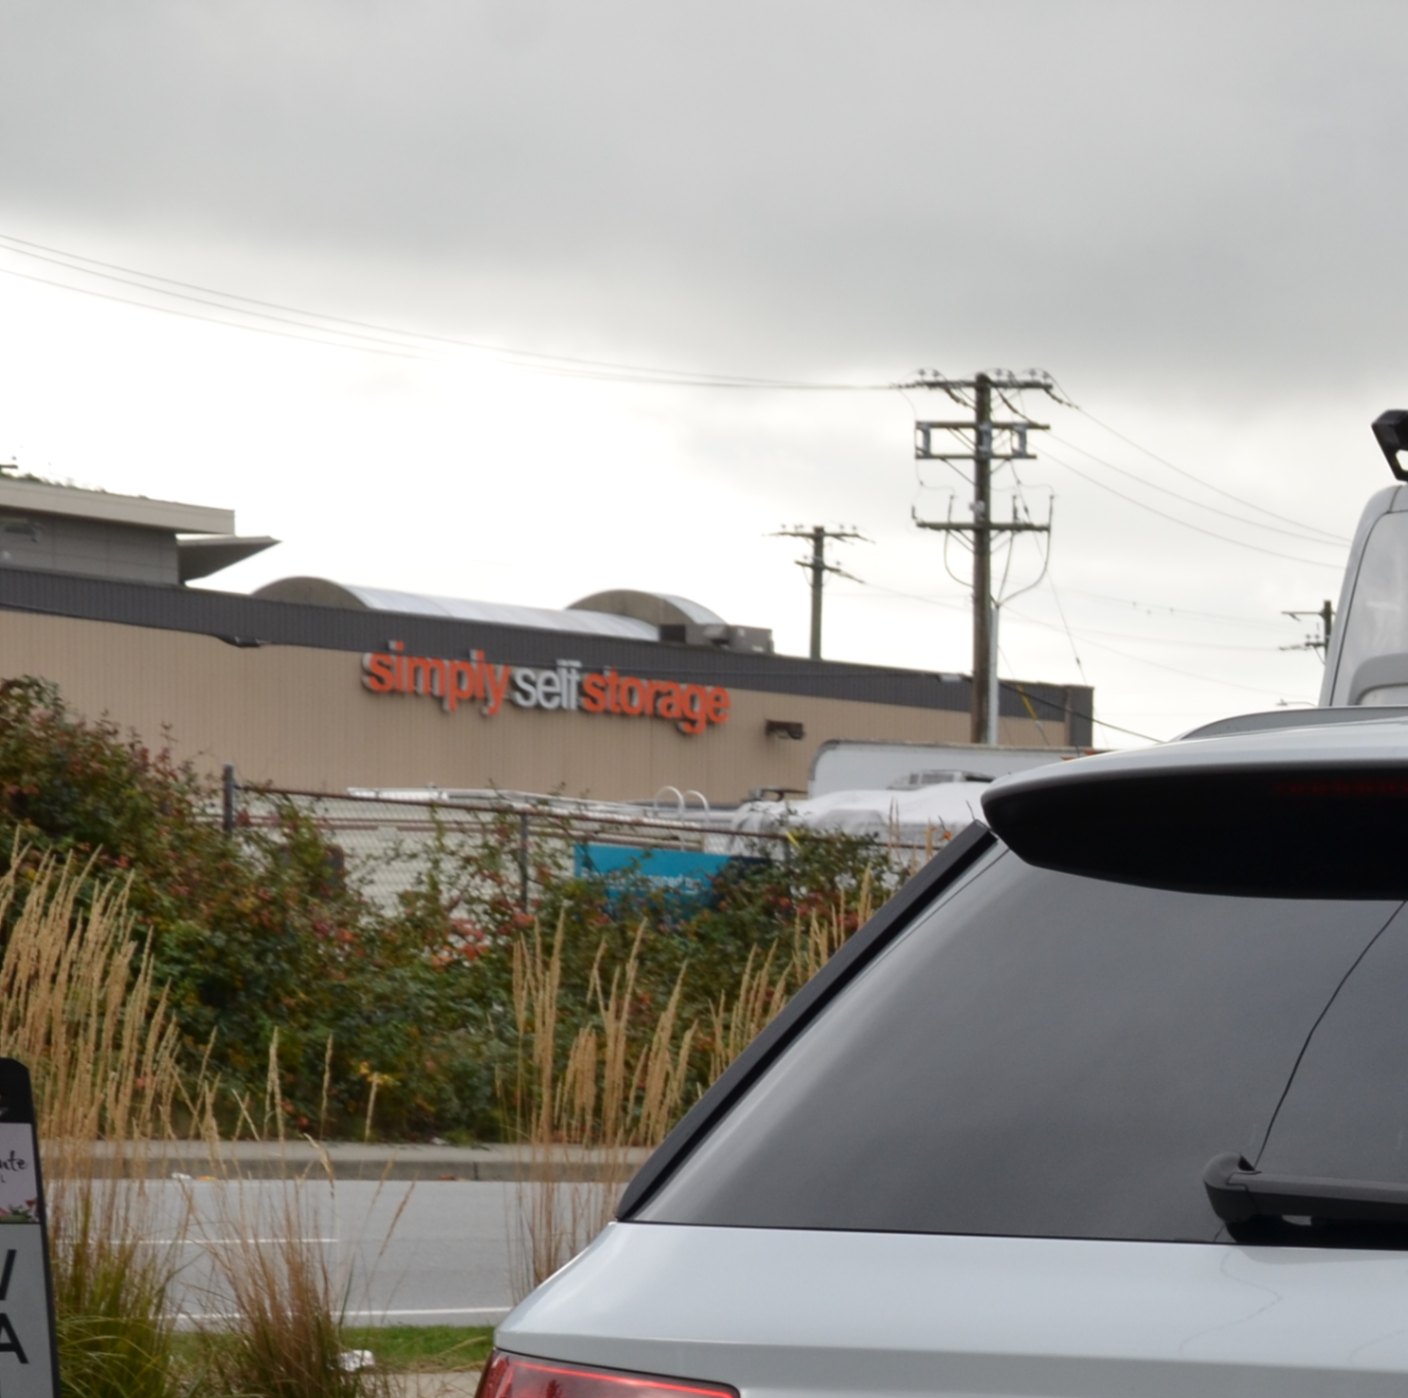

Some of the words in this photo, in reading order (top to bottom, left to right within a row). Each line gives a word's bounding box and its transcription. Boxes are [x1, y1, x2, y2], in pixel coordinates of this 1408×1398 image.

[362, 640, 511, 717] simply
[513, 659, 582, 711] self
[581, 666, 731, 735] storage
